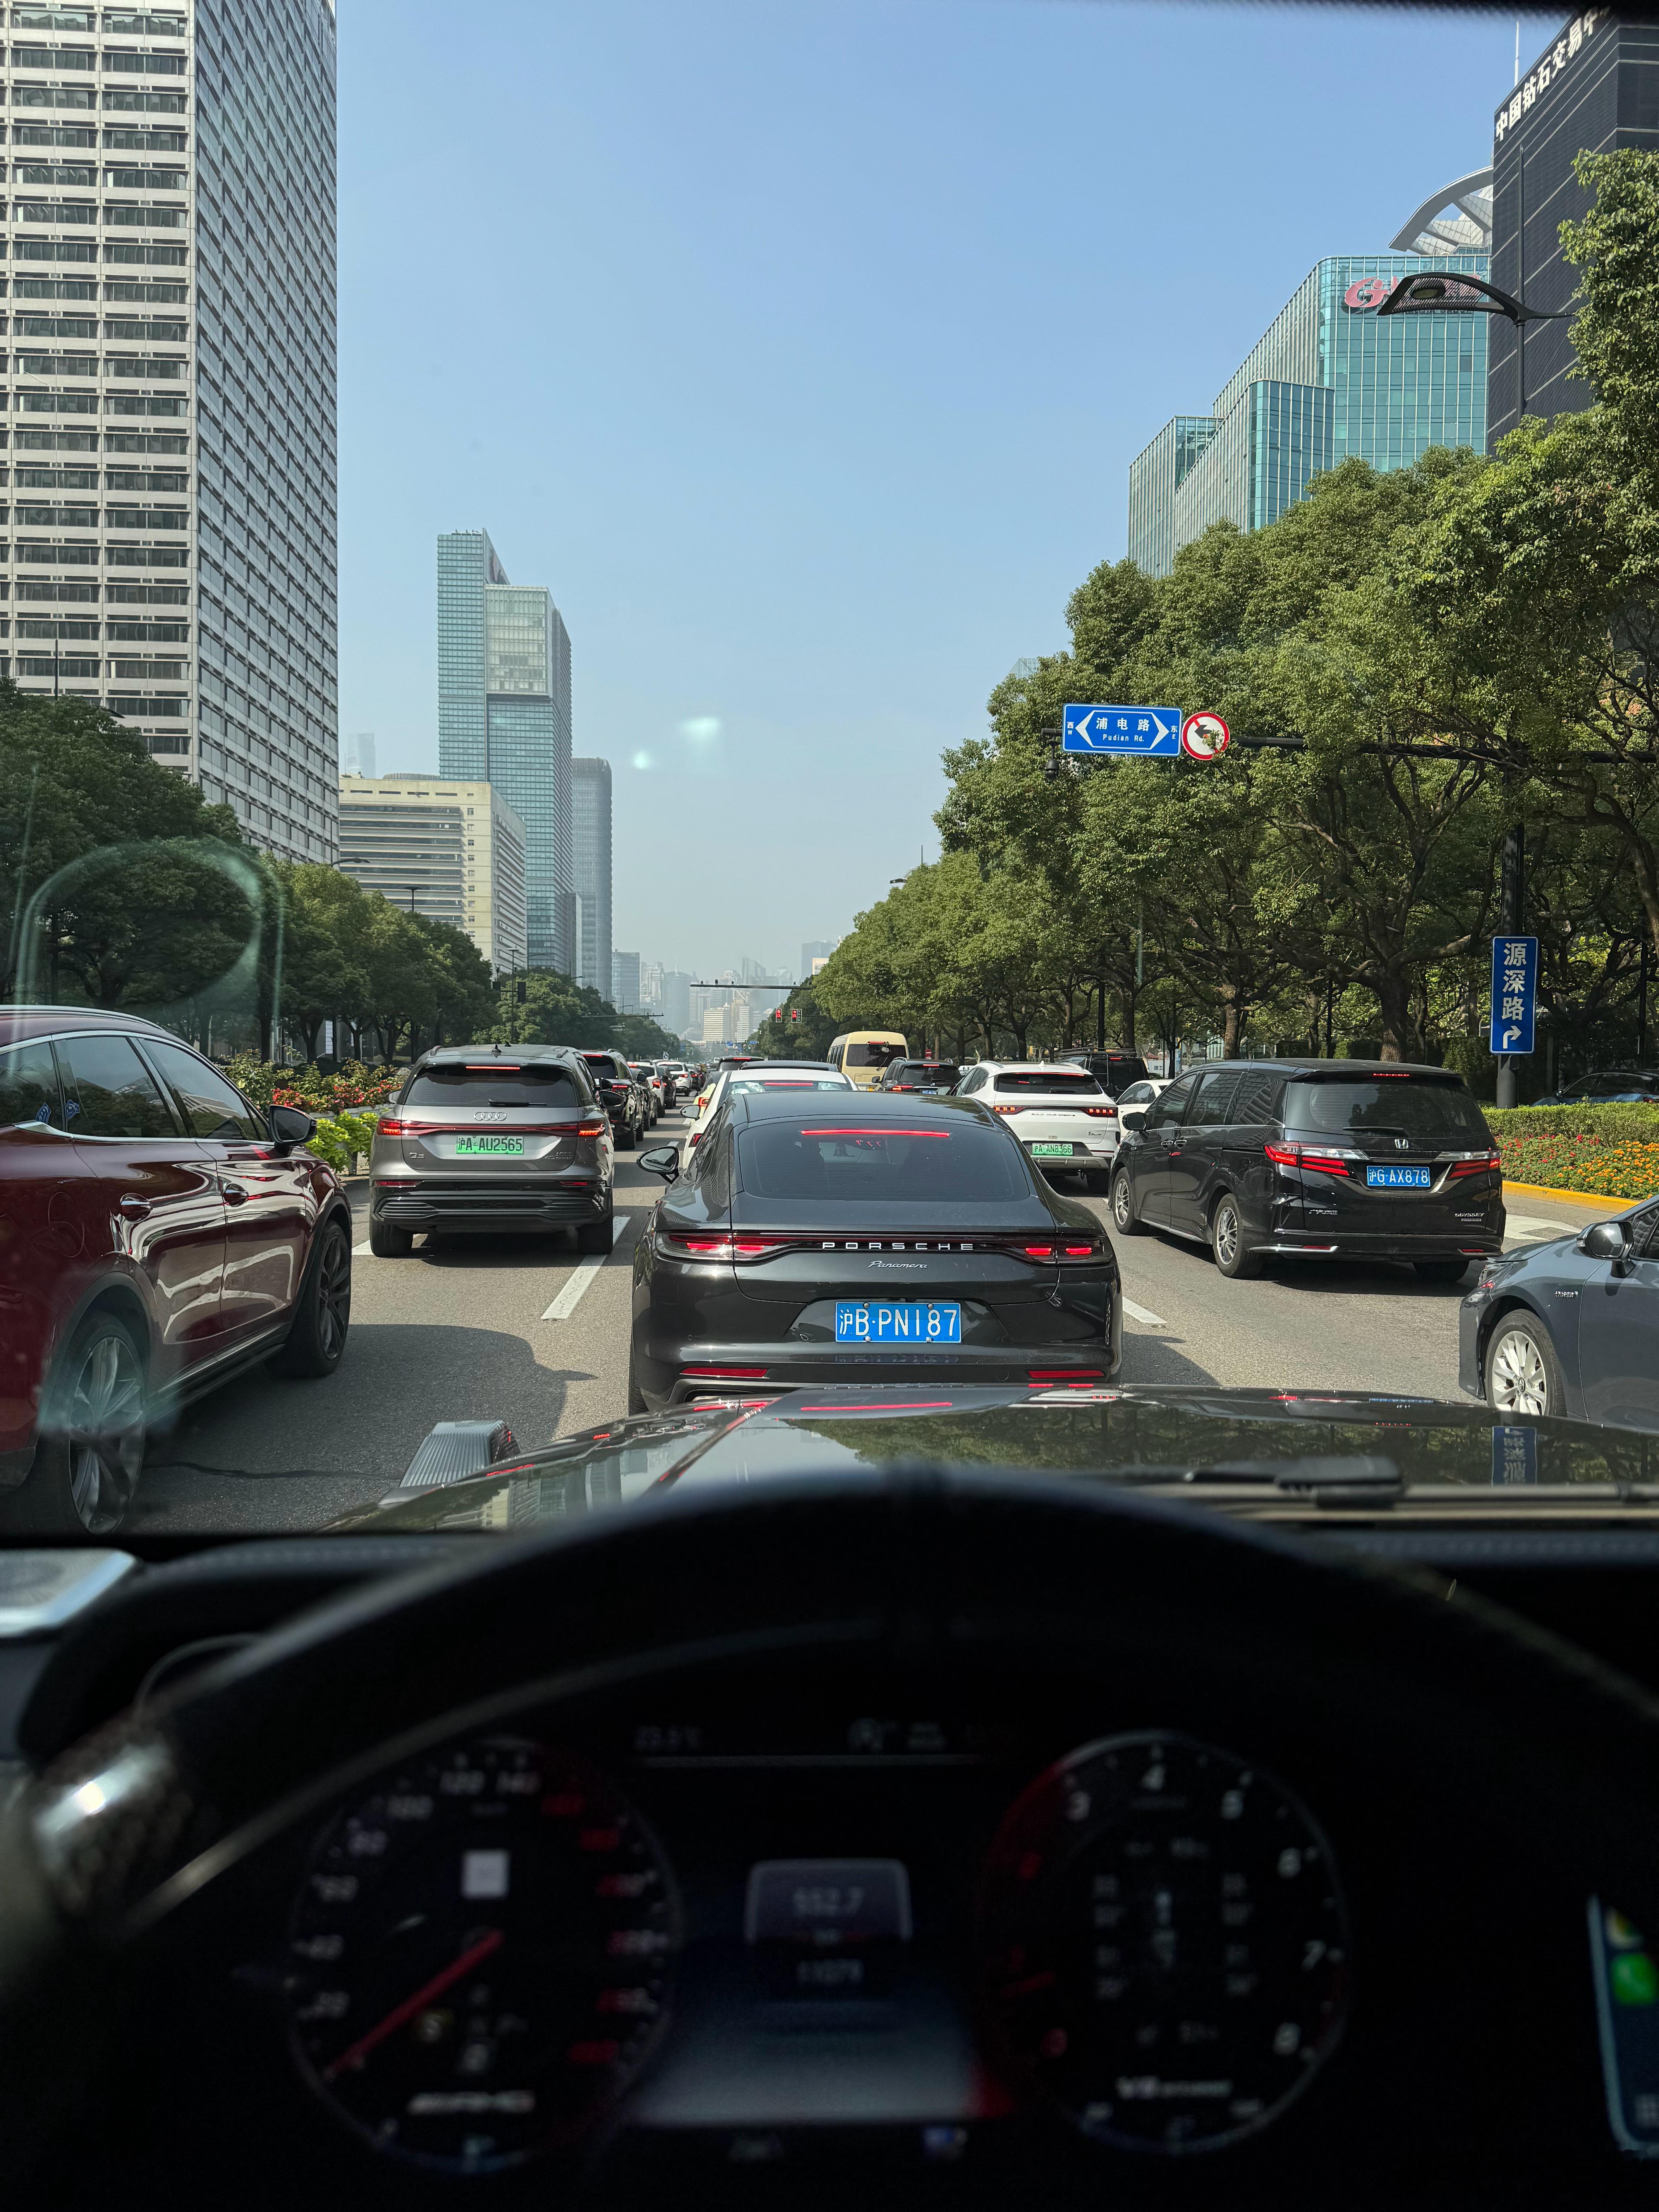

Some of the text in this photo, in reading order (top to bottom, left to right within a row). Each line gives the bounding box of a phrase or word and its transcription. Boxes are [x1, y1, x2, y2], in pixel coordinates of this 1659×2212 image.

[1496, 7, 1608, 141] 中国钻石交易中
[1096, 717, 1150, 732] 浦电路
[1171, 725, 1178, 733] 东
[1501, 943, 1527, 1020] 源深路
[479, 1138, 522, 1151] AU2565
[822, 1242, 974, 1250] PORSCHE
[868, 1261, 928, 1269] Panamera
